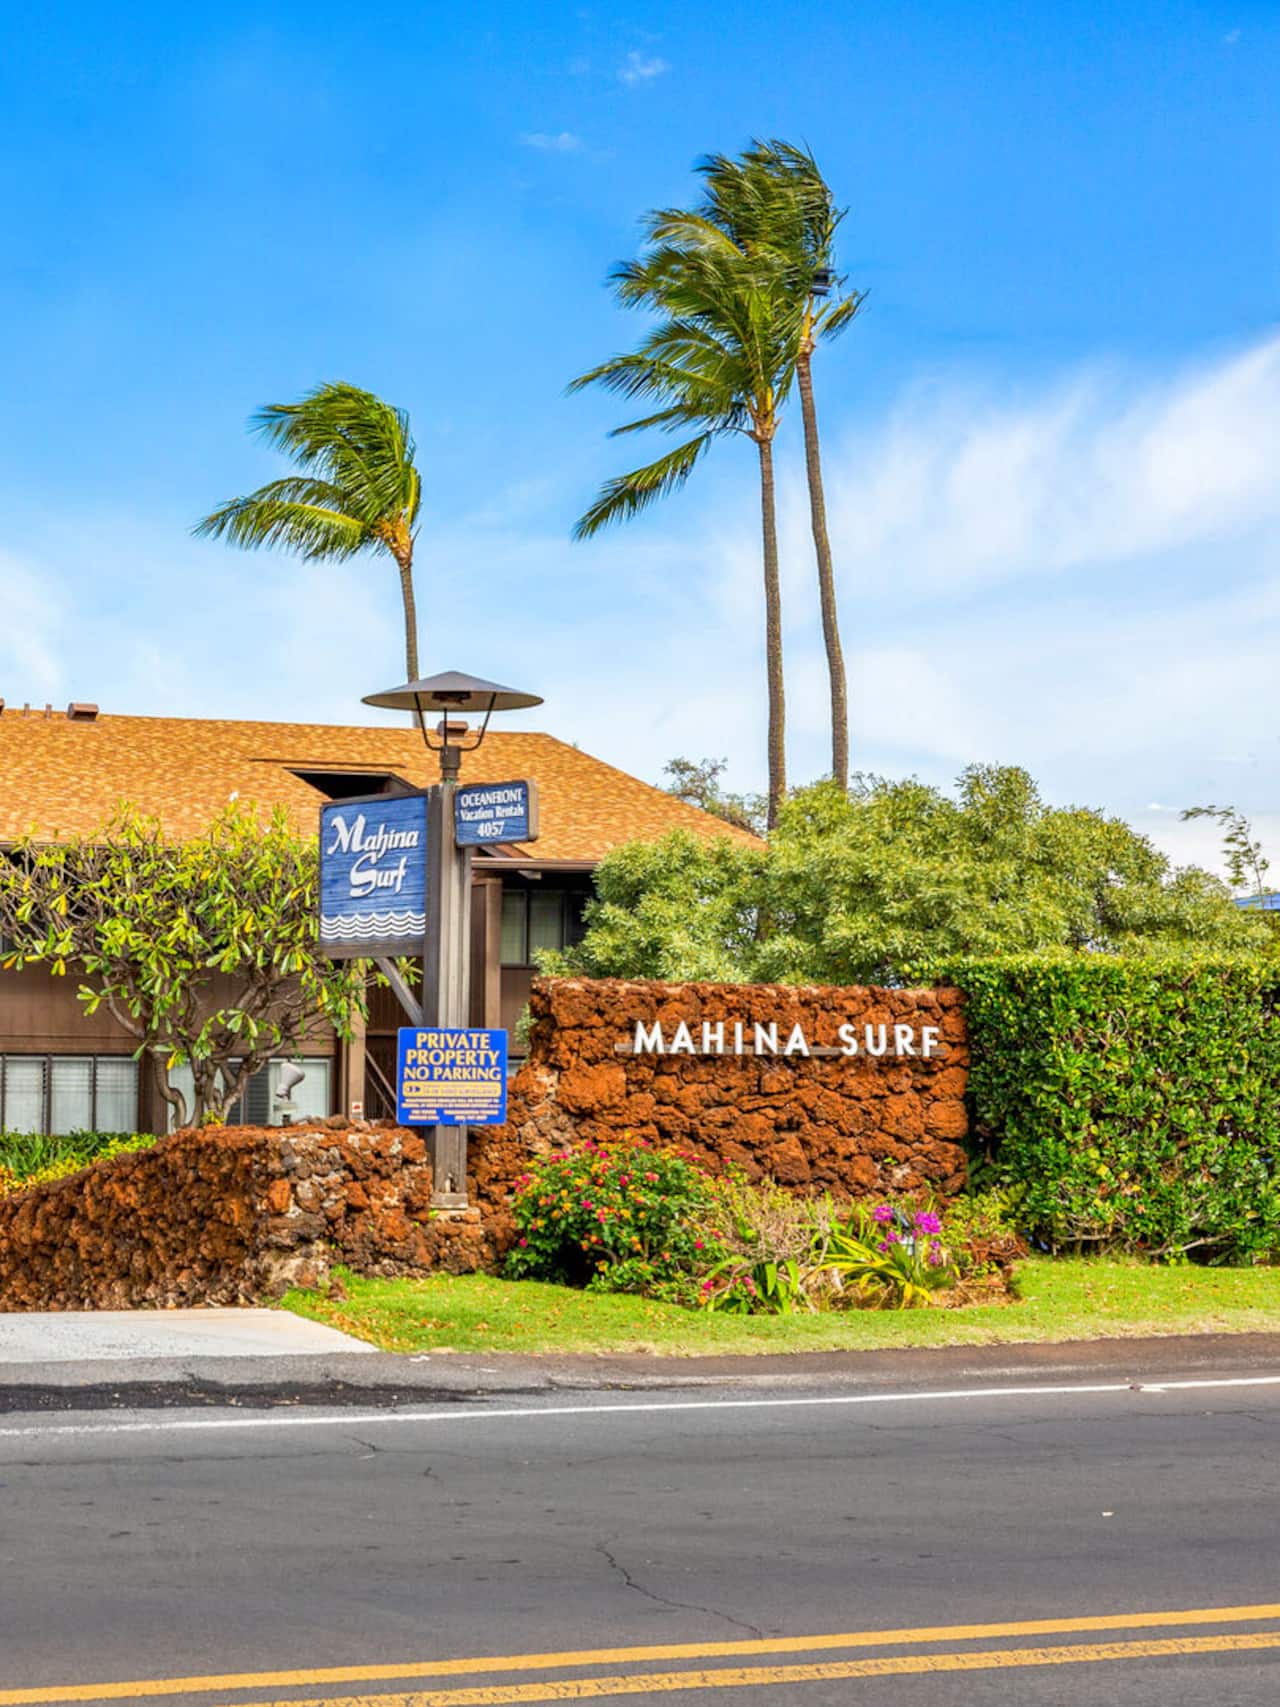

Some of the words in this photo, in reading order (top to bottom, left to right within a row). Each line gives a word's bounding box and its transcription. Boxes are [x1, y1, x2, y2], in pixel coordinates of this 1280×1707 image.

[461, 788, 523, 807] OCEANFRONT
[461, 808, 494, 821] Vacation
[495, 804, 524, 818] Rentals
[328, 814, 419, 858] Mahina
[477, 821, 505, 837] 4057
[350, 853, 407, 898] Surf
[416, 1032, 490, 1049] PRIVATE
[633, 1020, 810, 1057] MAHINA
[838, 1023, 940, 1057] SURF
[406, 1049, 499, 1066] PROPERTY
[403, 1066, 429, 1080] NO
[433, 1067, 501, 1080] PARKING
